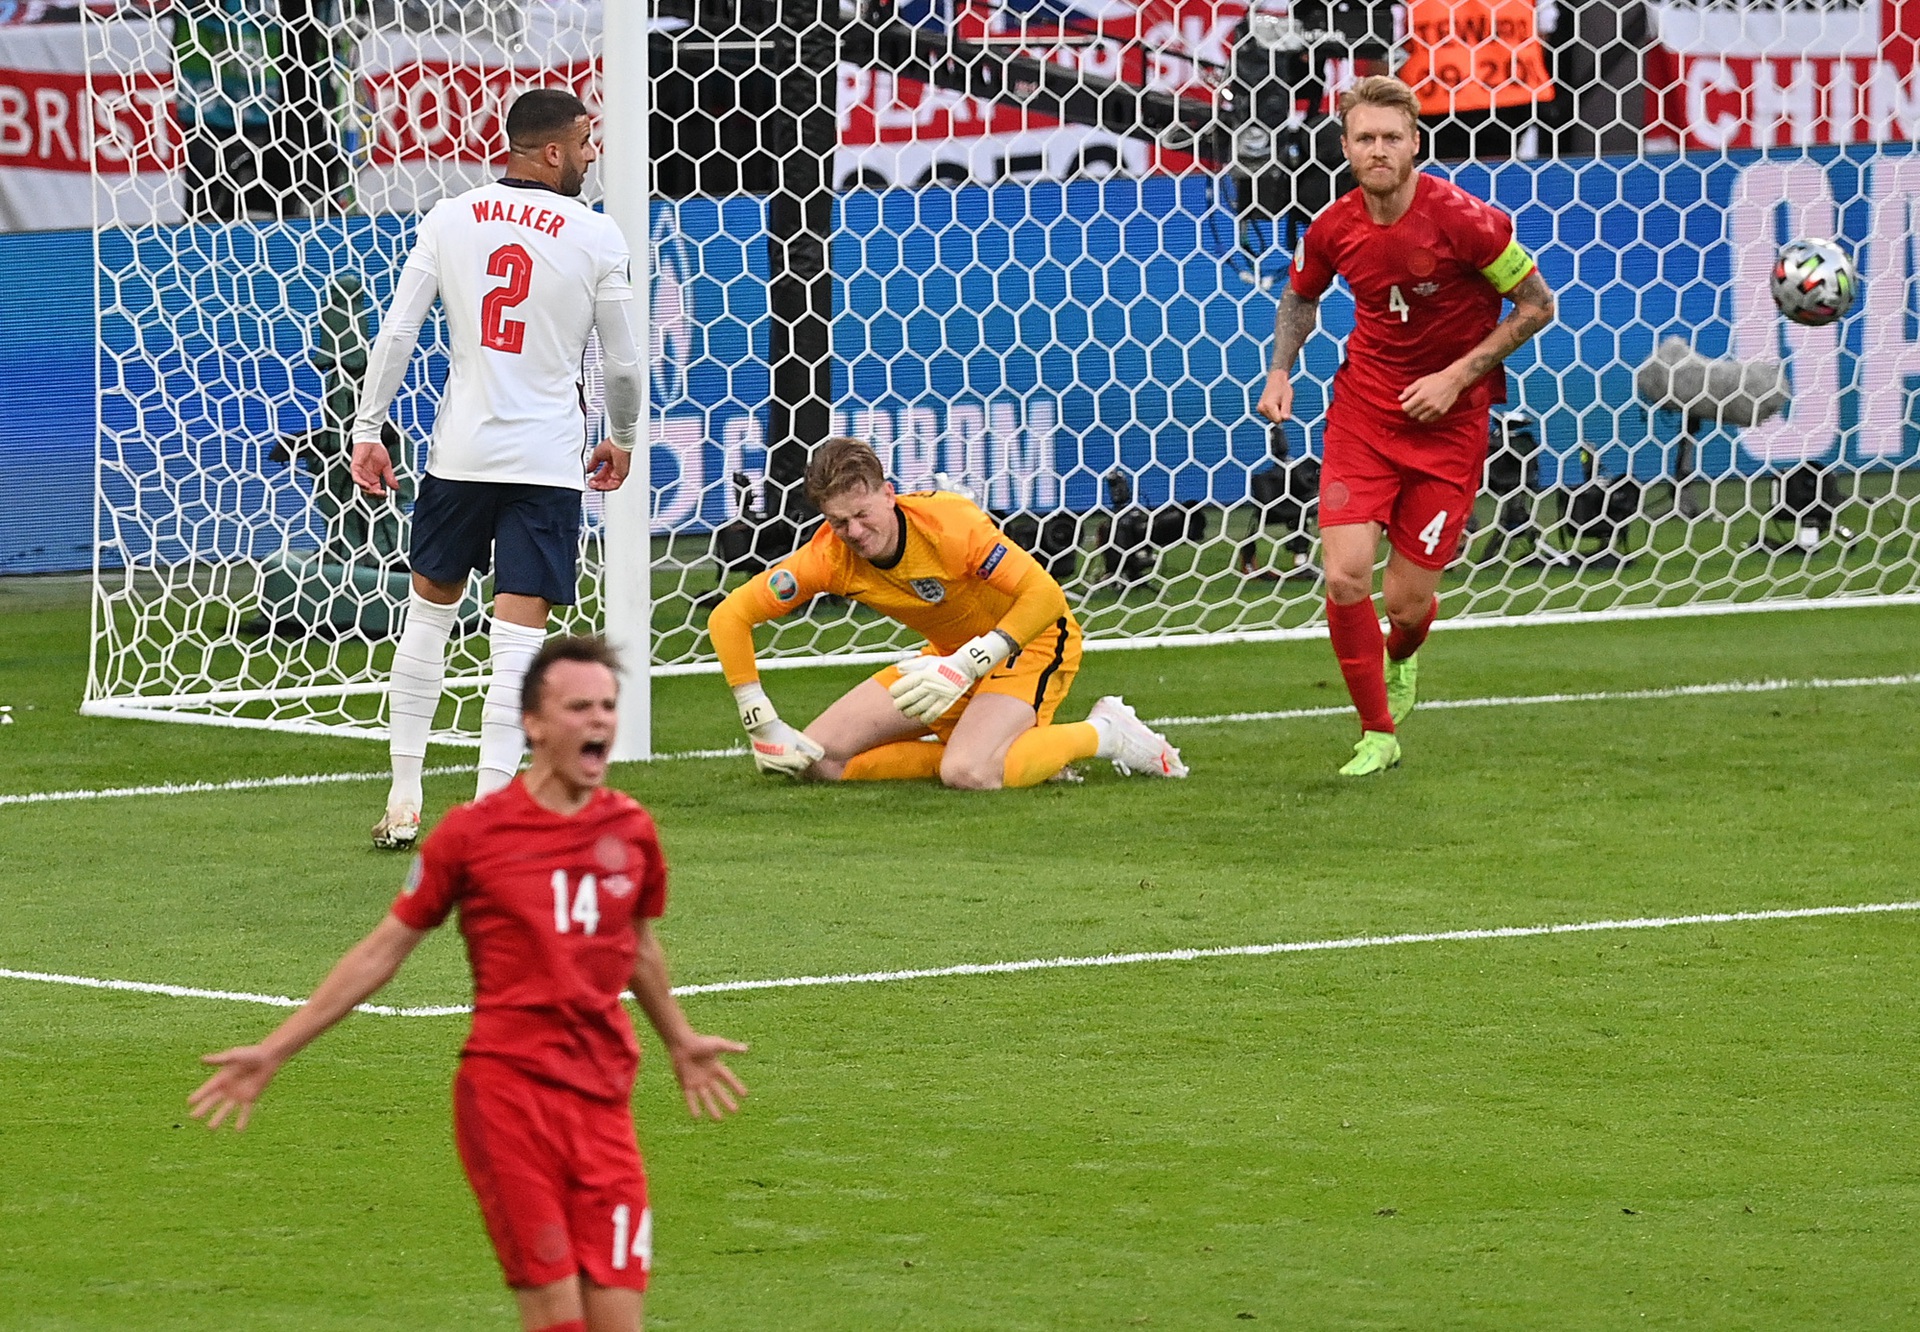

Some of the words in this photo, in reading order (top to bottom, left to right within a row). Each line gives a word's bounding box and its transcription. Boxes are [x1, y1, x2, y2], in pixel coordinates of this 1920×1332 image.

[1686, 59, 1920, 149] CHIN
[472, 200, 565, 238] WALKER
[481, 243, 533, 354] 2
[1389, 284, 1410, 323] 4
[1418, 510, 1448, 555] 4
[969, 647, 991, 664] JP
[743, 707, 761, 726] JP
[551, 869, 599, 936] 14
[612, 1204, 653, 1271] 14
